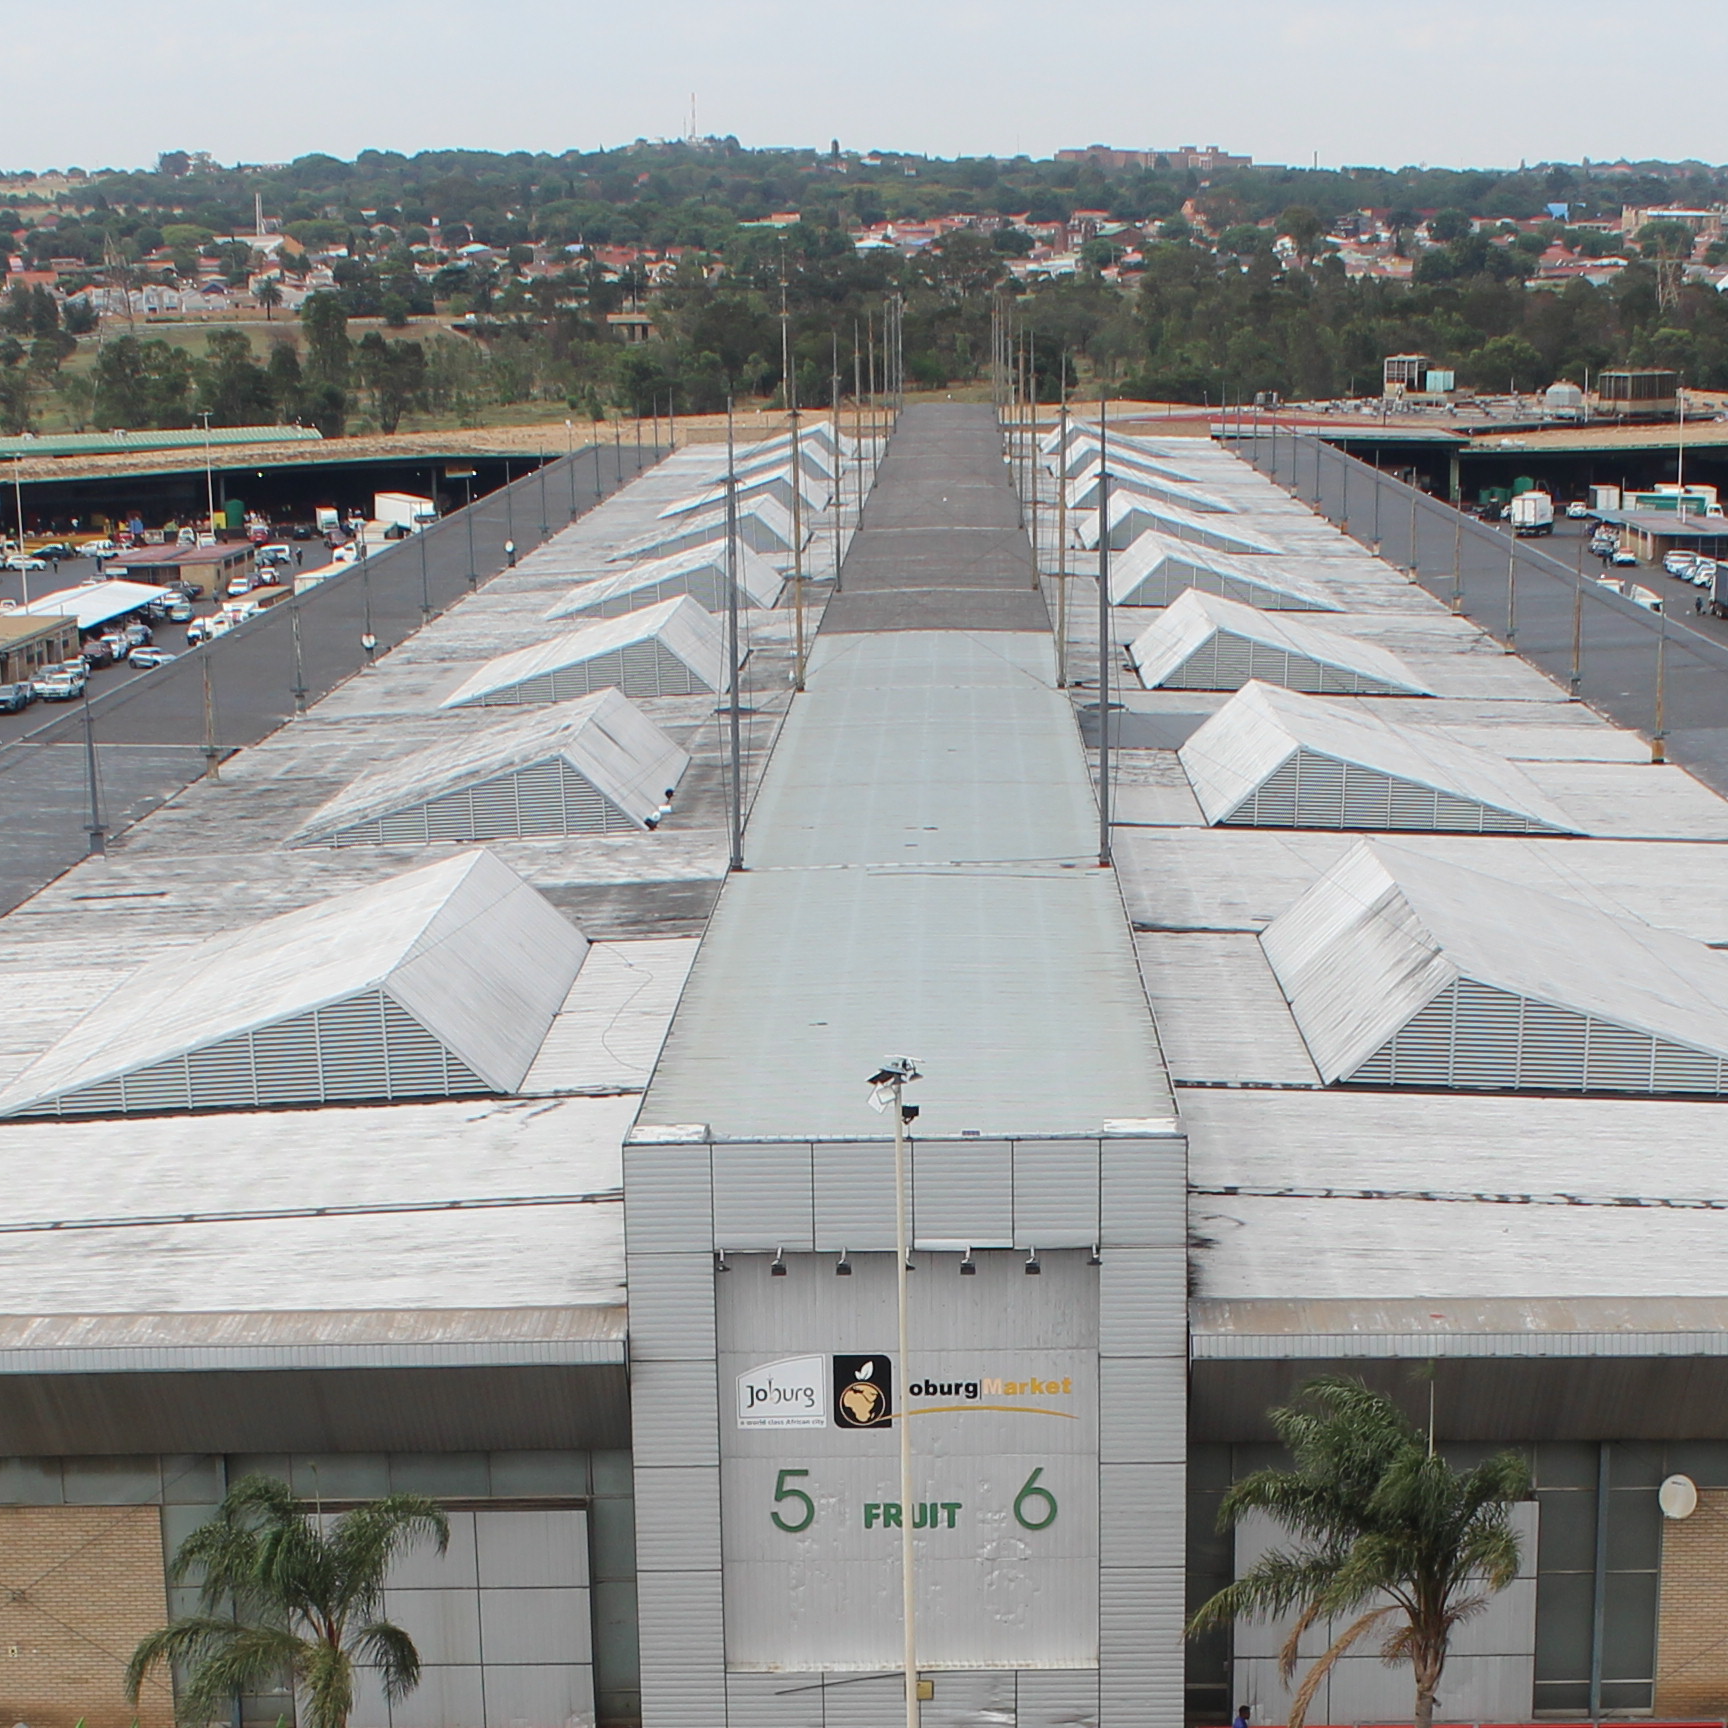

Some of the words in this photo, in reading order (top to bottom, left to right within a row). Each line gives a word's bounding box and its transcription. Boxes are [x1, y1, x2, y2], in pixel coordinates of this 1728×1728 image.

[745, 1374, 815, 1409] Joburg
[909, 1379, 978, 1400] oburg
[770, 1468, 815, 1533] 5
[863, 1501, 963, 1530] FRUIT
[1012, 1467, 1058, 1531] 6
